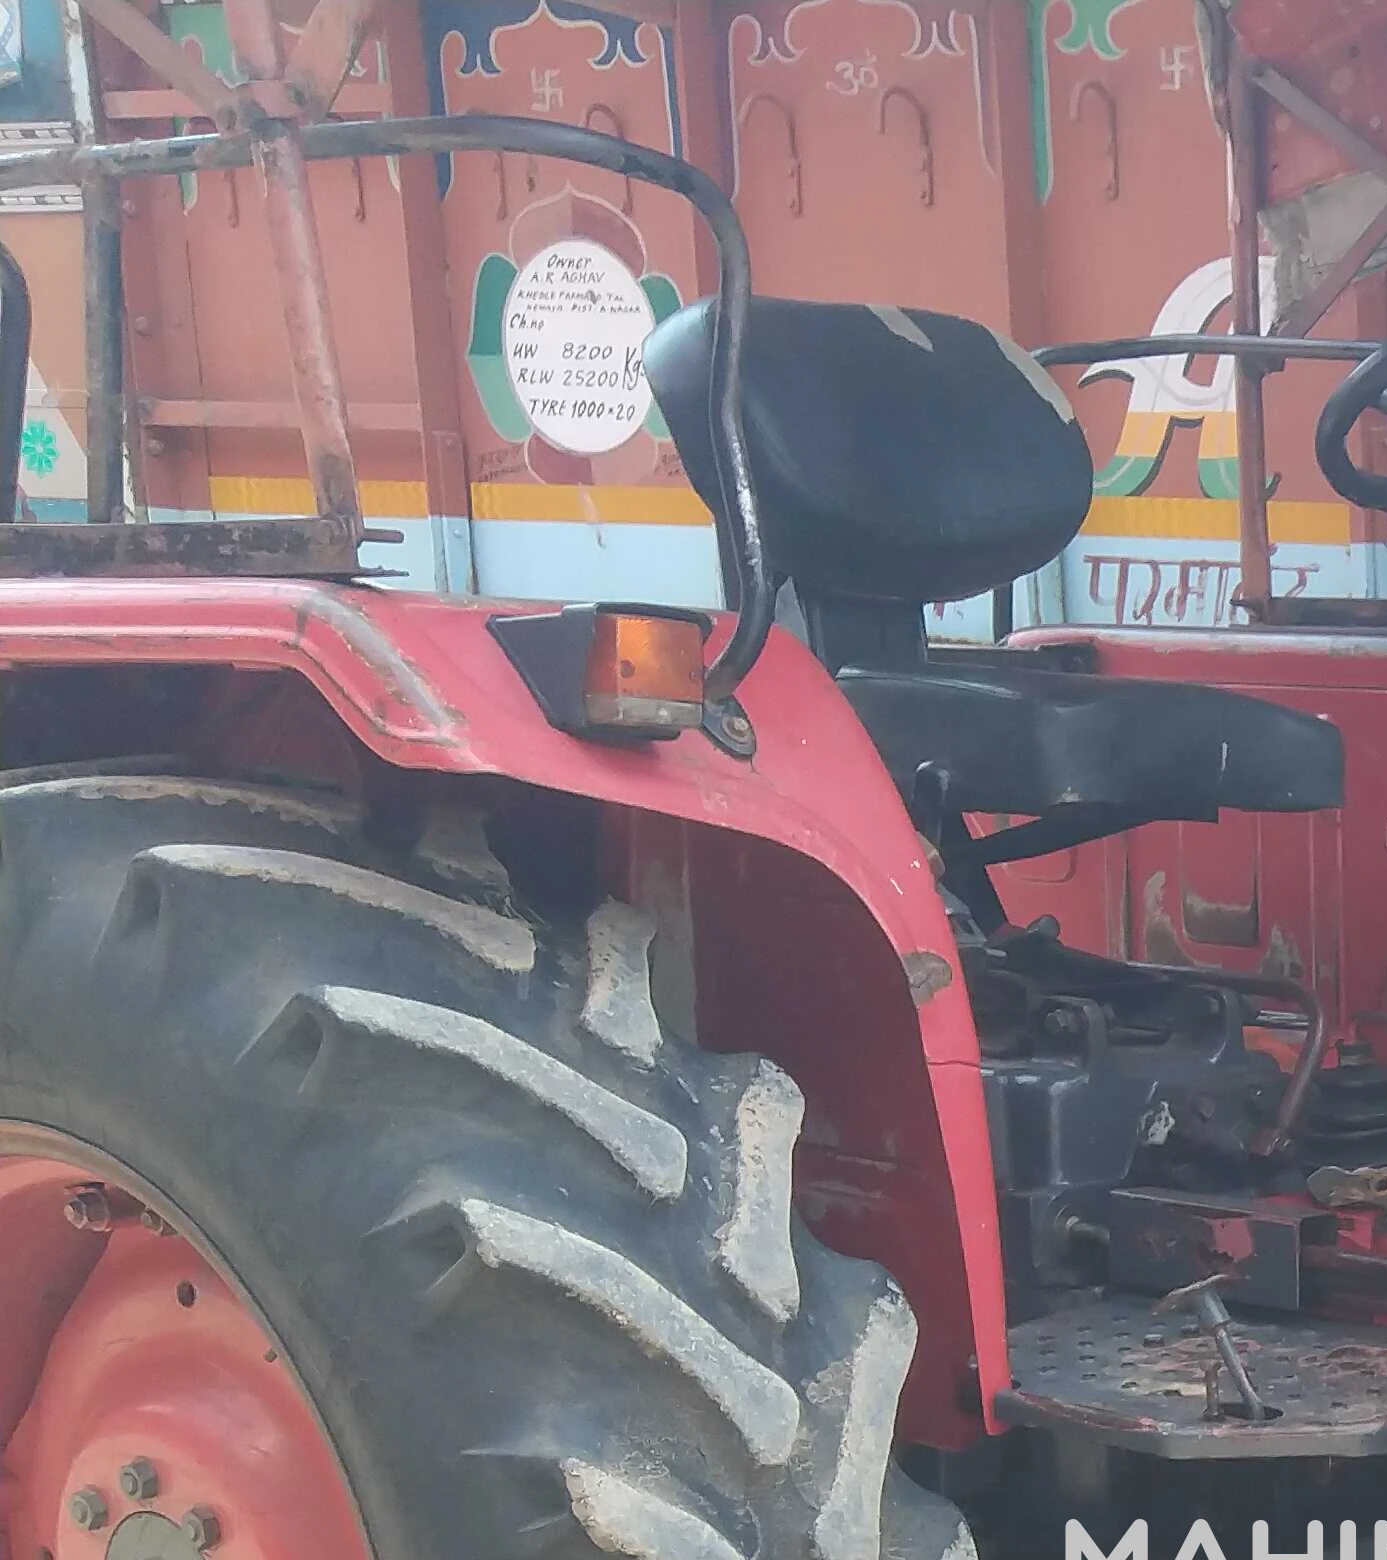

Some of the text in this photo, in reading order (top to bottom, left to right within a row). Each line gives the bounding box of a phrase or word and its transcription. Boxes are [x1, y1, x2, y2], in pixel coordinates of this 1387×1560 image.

[560, 271, 605, 285] AGHAV
[561, 341, 613, 361] 8200
[516, 367, 619, 388] RLW 25200
[528, 398, 567, 416] TYRE
